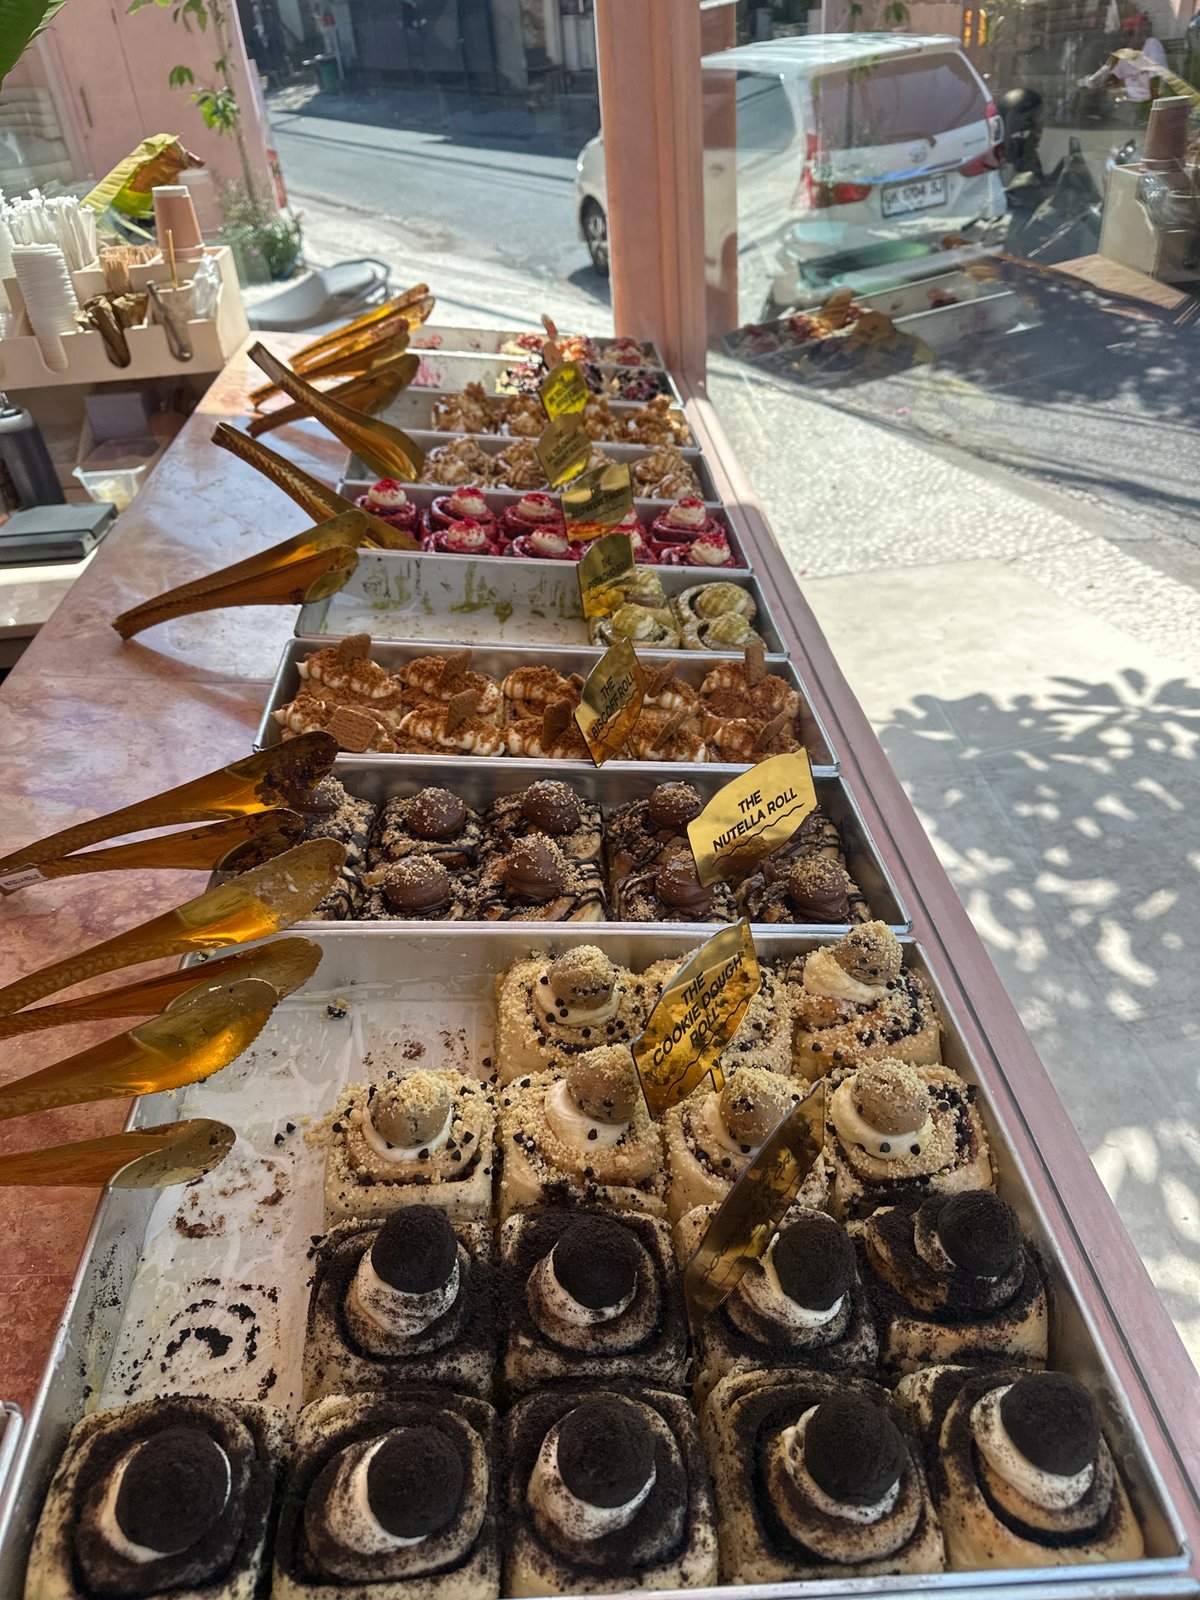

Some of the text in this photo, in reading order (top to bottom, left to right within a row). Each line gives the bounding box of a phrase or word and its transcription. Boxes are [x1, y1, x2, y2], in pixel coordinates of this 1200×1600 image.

[601, 555, 613, 568] THE
[591, 671, 635, 740] BISCOFF ROLL
[600, 676, 616, 700] THE
[712, 787, 797, 852] NUTELLA ROLL
[738, 790, 763, 813] THE
[680, 971, 706, 1006] THE
[653, 951, 746, 1067] COOKIE DOUGH
[689, 1008, 720, 1050] ROLL
